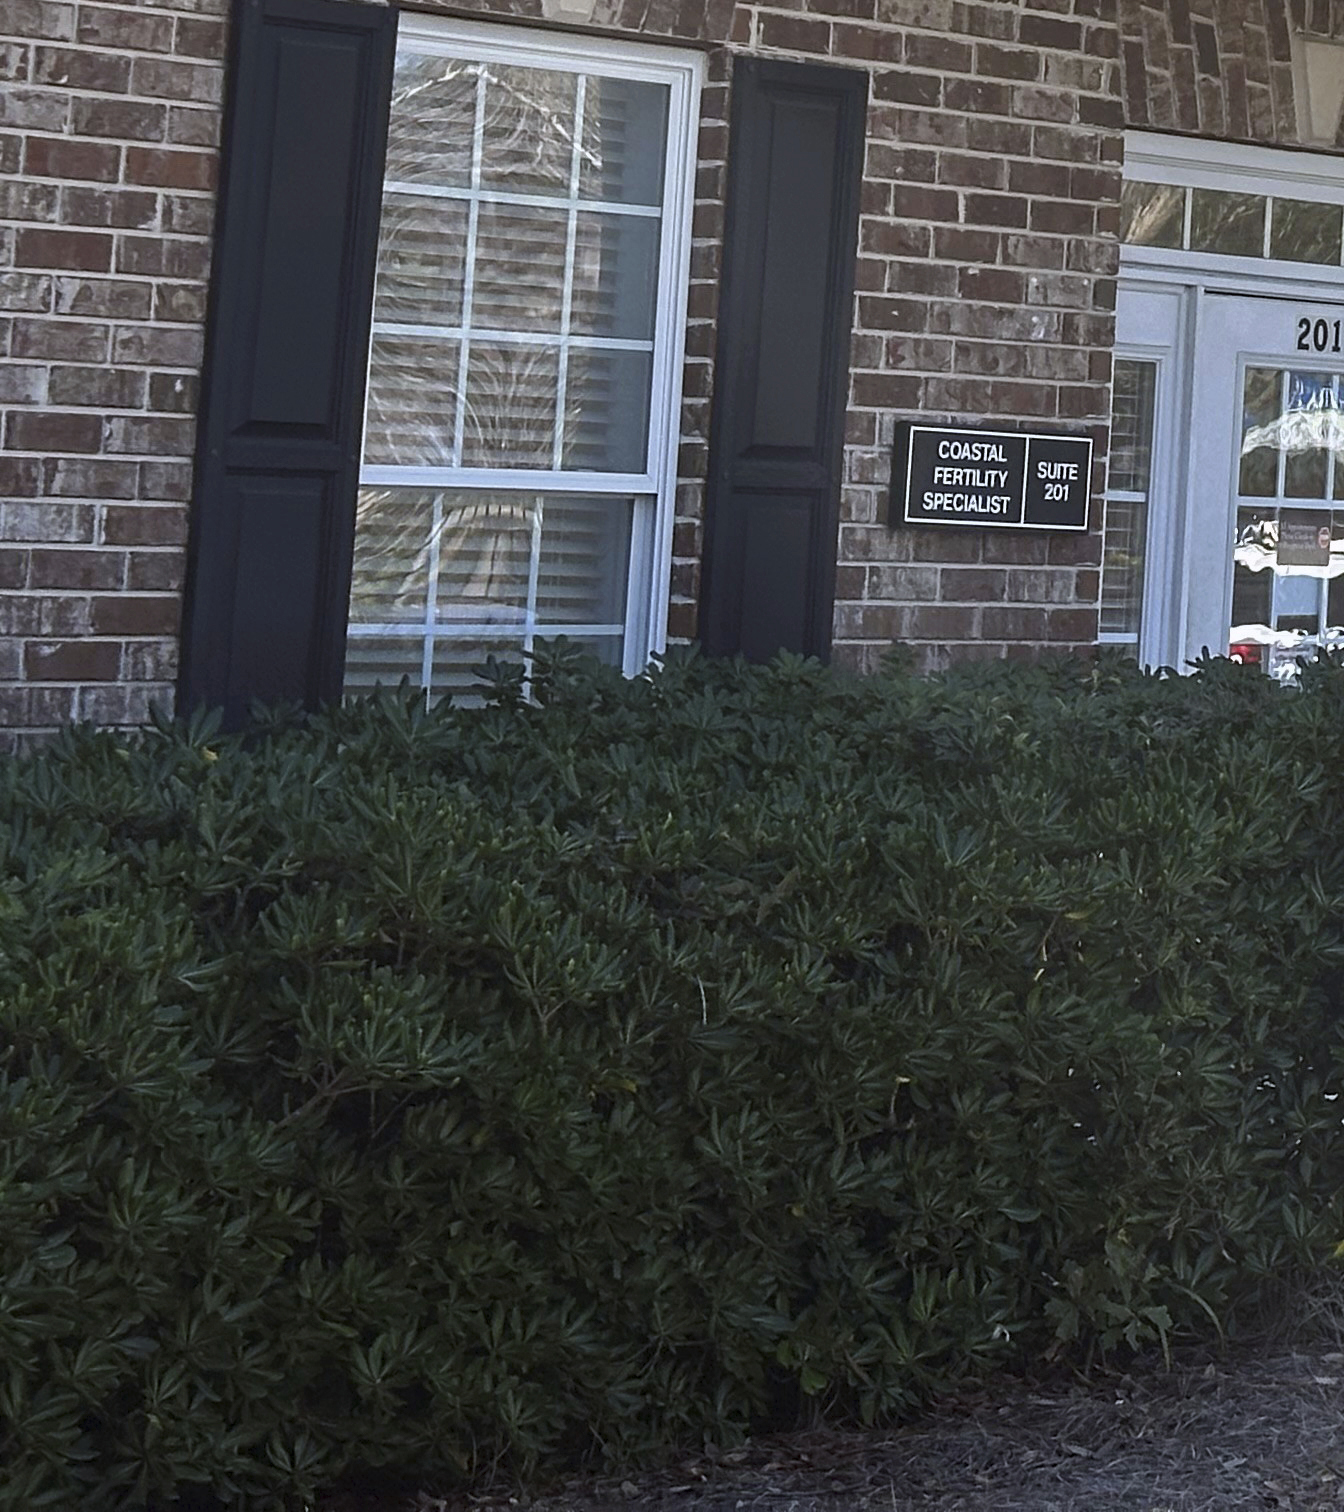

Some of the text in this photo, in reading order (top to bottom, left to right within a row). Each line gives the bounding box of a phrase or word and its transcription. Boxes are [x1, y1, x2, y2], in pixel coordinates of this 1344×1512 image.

[1297, 317, 1341, 353] 201
[938, 440, 1008, 463] COASTAL
[933, 466, 1009, 488] FERTILITY
[1036, 461, 1079, 481] SUITE
[922, 491, 1011, 514] SPECIALIST
[1044, 484, 1070, 502] 201
